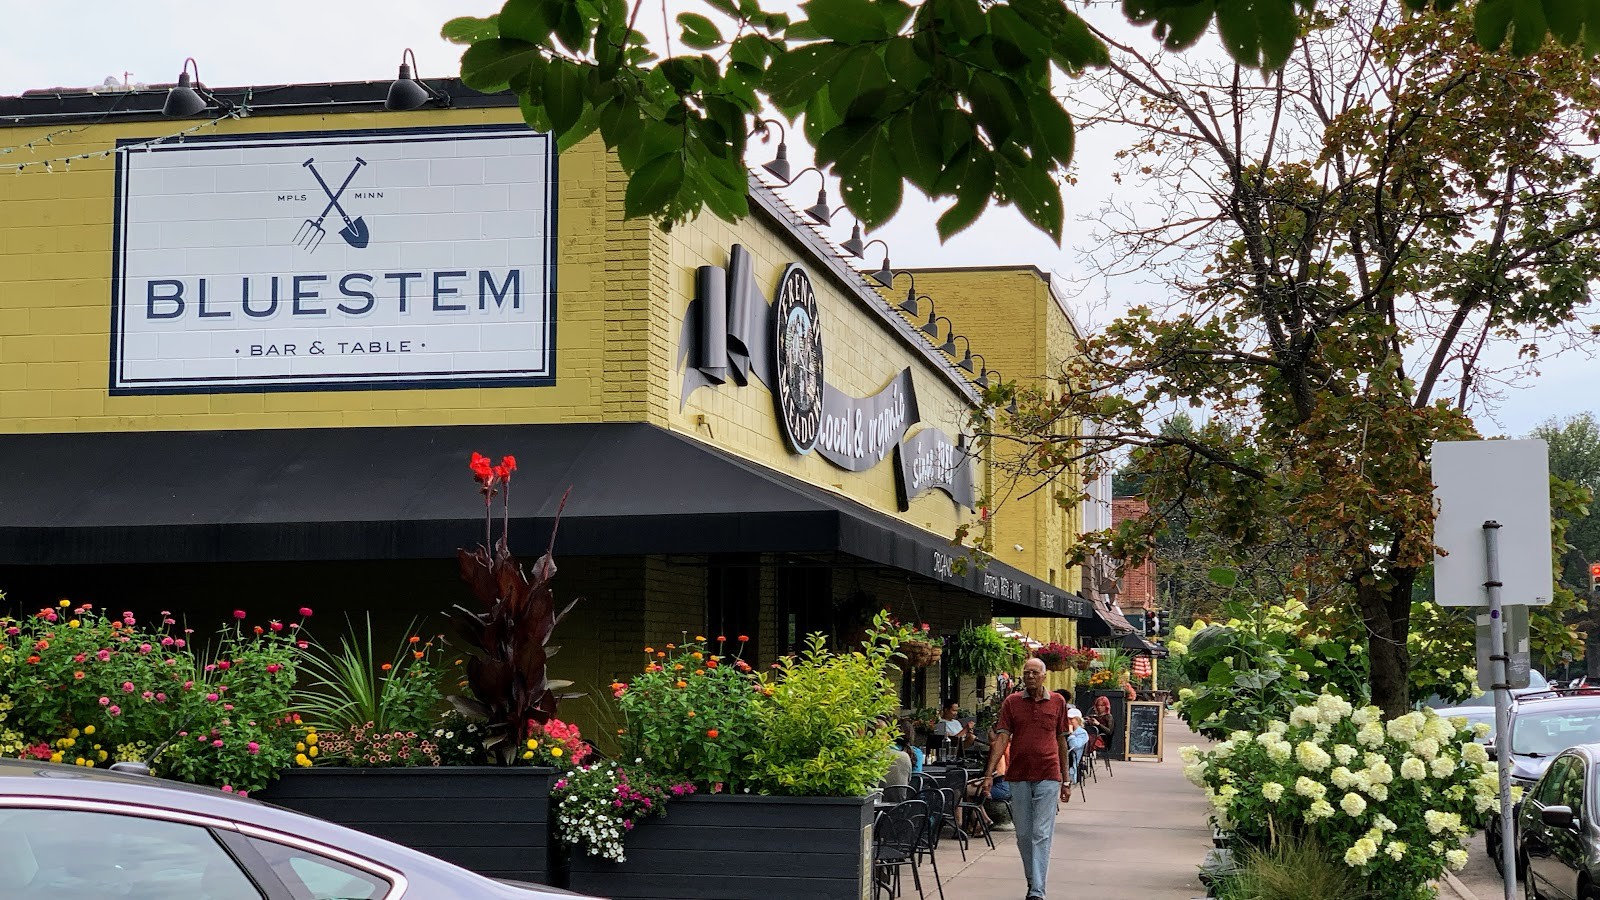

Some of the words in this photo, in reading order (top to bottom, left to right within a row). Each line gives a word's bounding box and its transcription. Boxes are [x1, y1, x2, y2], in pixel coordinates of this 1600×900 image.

[277, 193, 307, 202] MPLS
[354, 191, 385, 200] MINN
[146, 268, 521, 320] BLUESTEM
[782, 273, 820, 347] FRENCH
[250, 342, 298, 357] BAR
[308, 340, 326, 356] &
[337, 340, 412, 355] TABLE
[781, 366, 822, 444] MEADOW
[854, 407, 864, 459] &
[868, 383, 905, 462] organic
